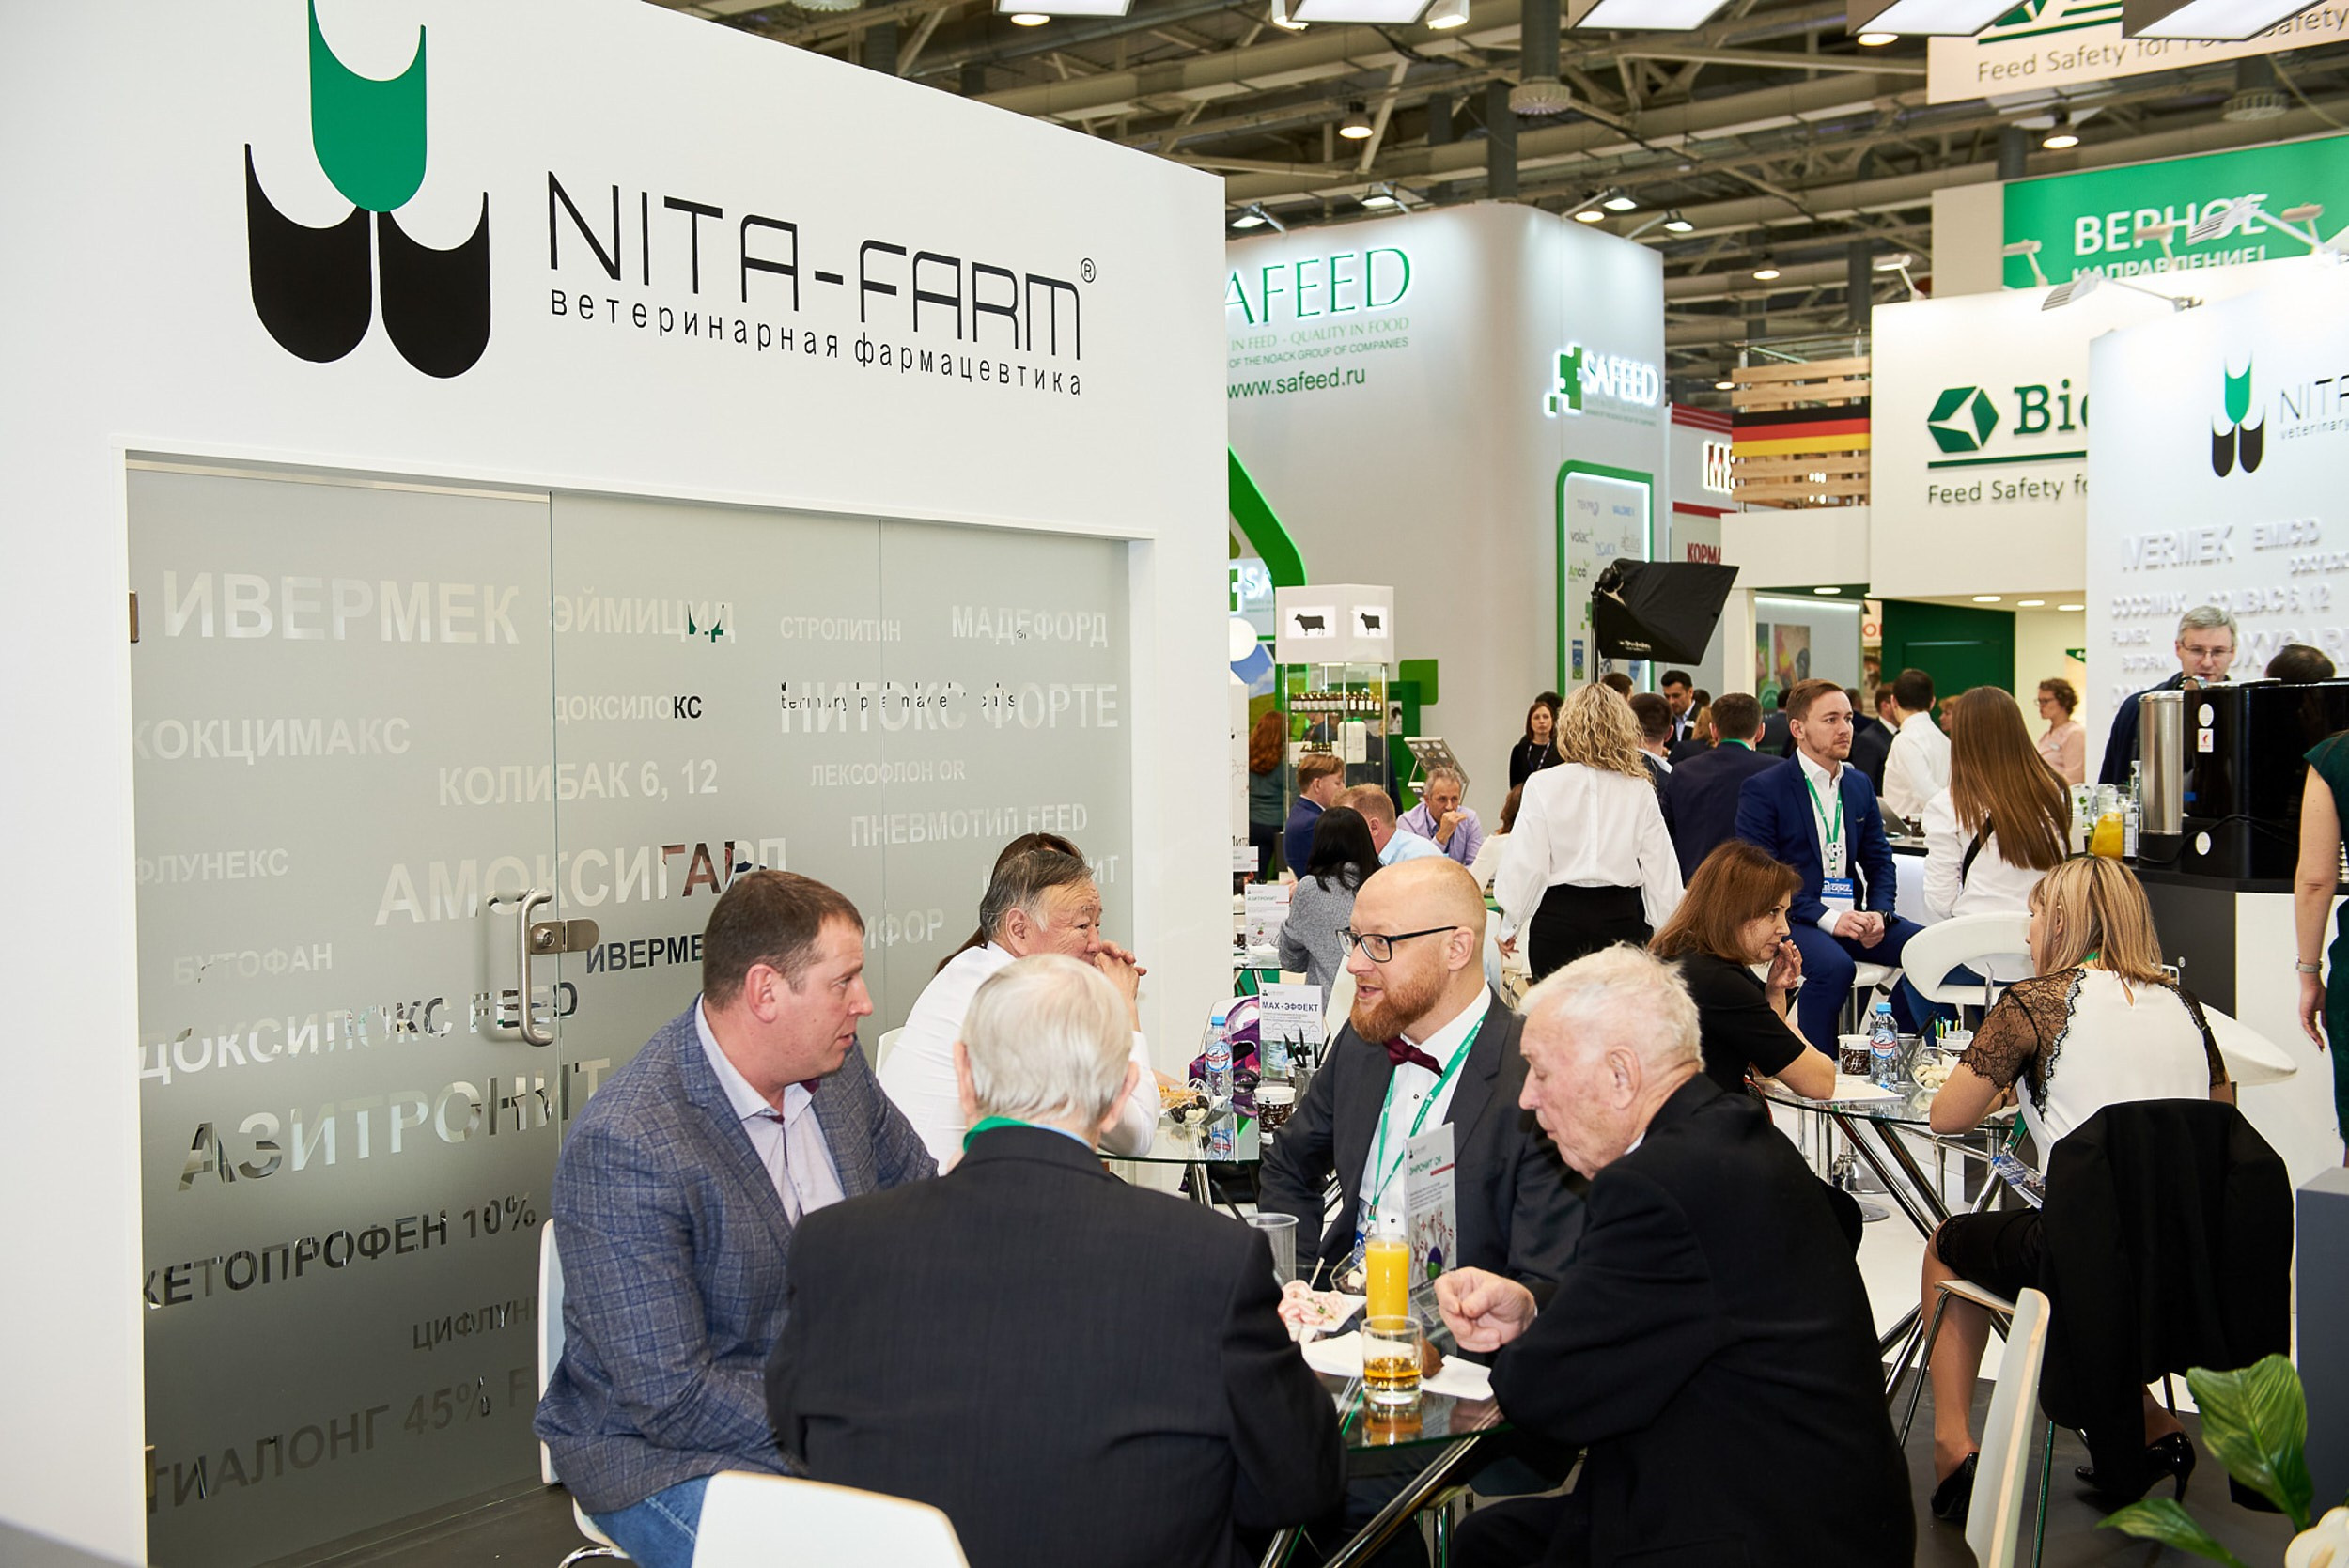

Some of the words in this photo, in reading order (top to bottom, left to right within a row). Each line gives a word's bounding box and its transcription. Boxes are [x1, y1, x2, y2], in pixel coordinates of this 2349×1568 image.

[1978, 54, 2036, 82] Feed
[2046, 41, 2127, 72] Safety
[1225, 247, 1410, 325] AFEED
[551, 288, 839, 360] ветеринарная
[854, 331, 1081, 396] фармацевтика
[1228, 358, 1244, 369] OF
[1244, 355, 1262, 366] THE
[1262, 350, 1297, 365] NOACK
[1297, 347, 1332, 361] GROUP
[1333, 344, 1347, 356] OF
[1349, 336, 1409, 354] COMPANIES
[1231, 337, 1245, 351] IN
[1248, 334, 1278, 349] FEED
[1290, 325, 1347, 345] QUALITY
[1350, 322, 1365, 336] IN
[1368, 317, 1409, 334] FOOD
[1227, 367, 1366, 399] www.safeed.ru
[1582, 350, 1660, 406] SAFEED
[1928, 481, 1982, 504] Feed
[1992, 476, 2064, 501] Safety
[2121, 524, 2234, 572] IVERMEK
[2252, 517, 2322, 552] EMICID
[163, 570, 521, 644] ИВЕРМЕК
[549, 586, 736, 644] ЭЙМИЦИД
[780, 616, 902, 642] СТРОЛИТИН
[952, 605, 1109, 648] МАДЕФОРД
[552, 695, 703, 724] ДОКСИЛОКС
[781, 680, 967, 734] НИТОКС
[982, 681, 1119, 730] ФОРТЕ
[439, 761, 630, 808] КОЛИБАК
[640, 759, 669, 803] 6,
[681, 758, 718, 795] 12
[810, 761, 933, 786] ЛЕКСОФЛОН
[940, 760, 965, 780] OR
[850, 805, 1018, 847] ПНЕВМОТИЛ
[1027, 802, 1087, 834] FEED
[173, 942, 334, 985] БУТОФАН
[586, 933, 704, 974] ИВЕРМЕ
[470, 982, 578, 1034] FEED
[178, 1057, 610, 1191] АЗИТРОНИТ
[462, 1192, 537, 1240] 10%
[404, 1374, 490, 1436] 45%
